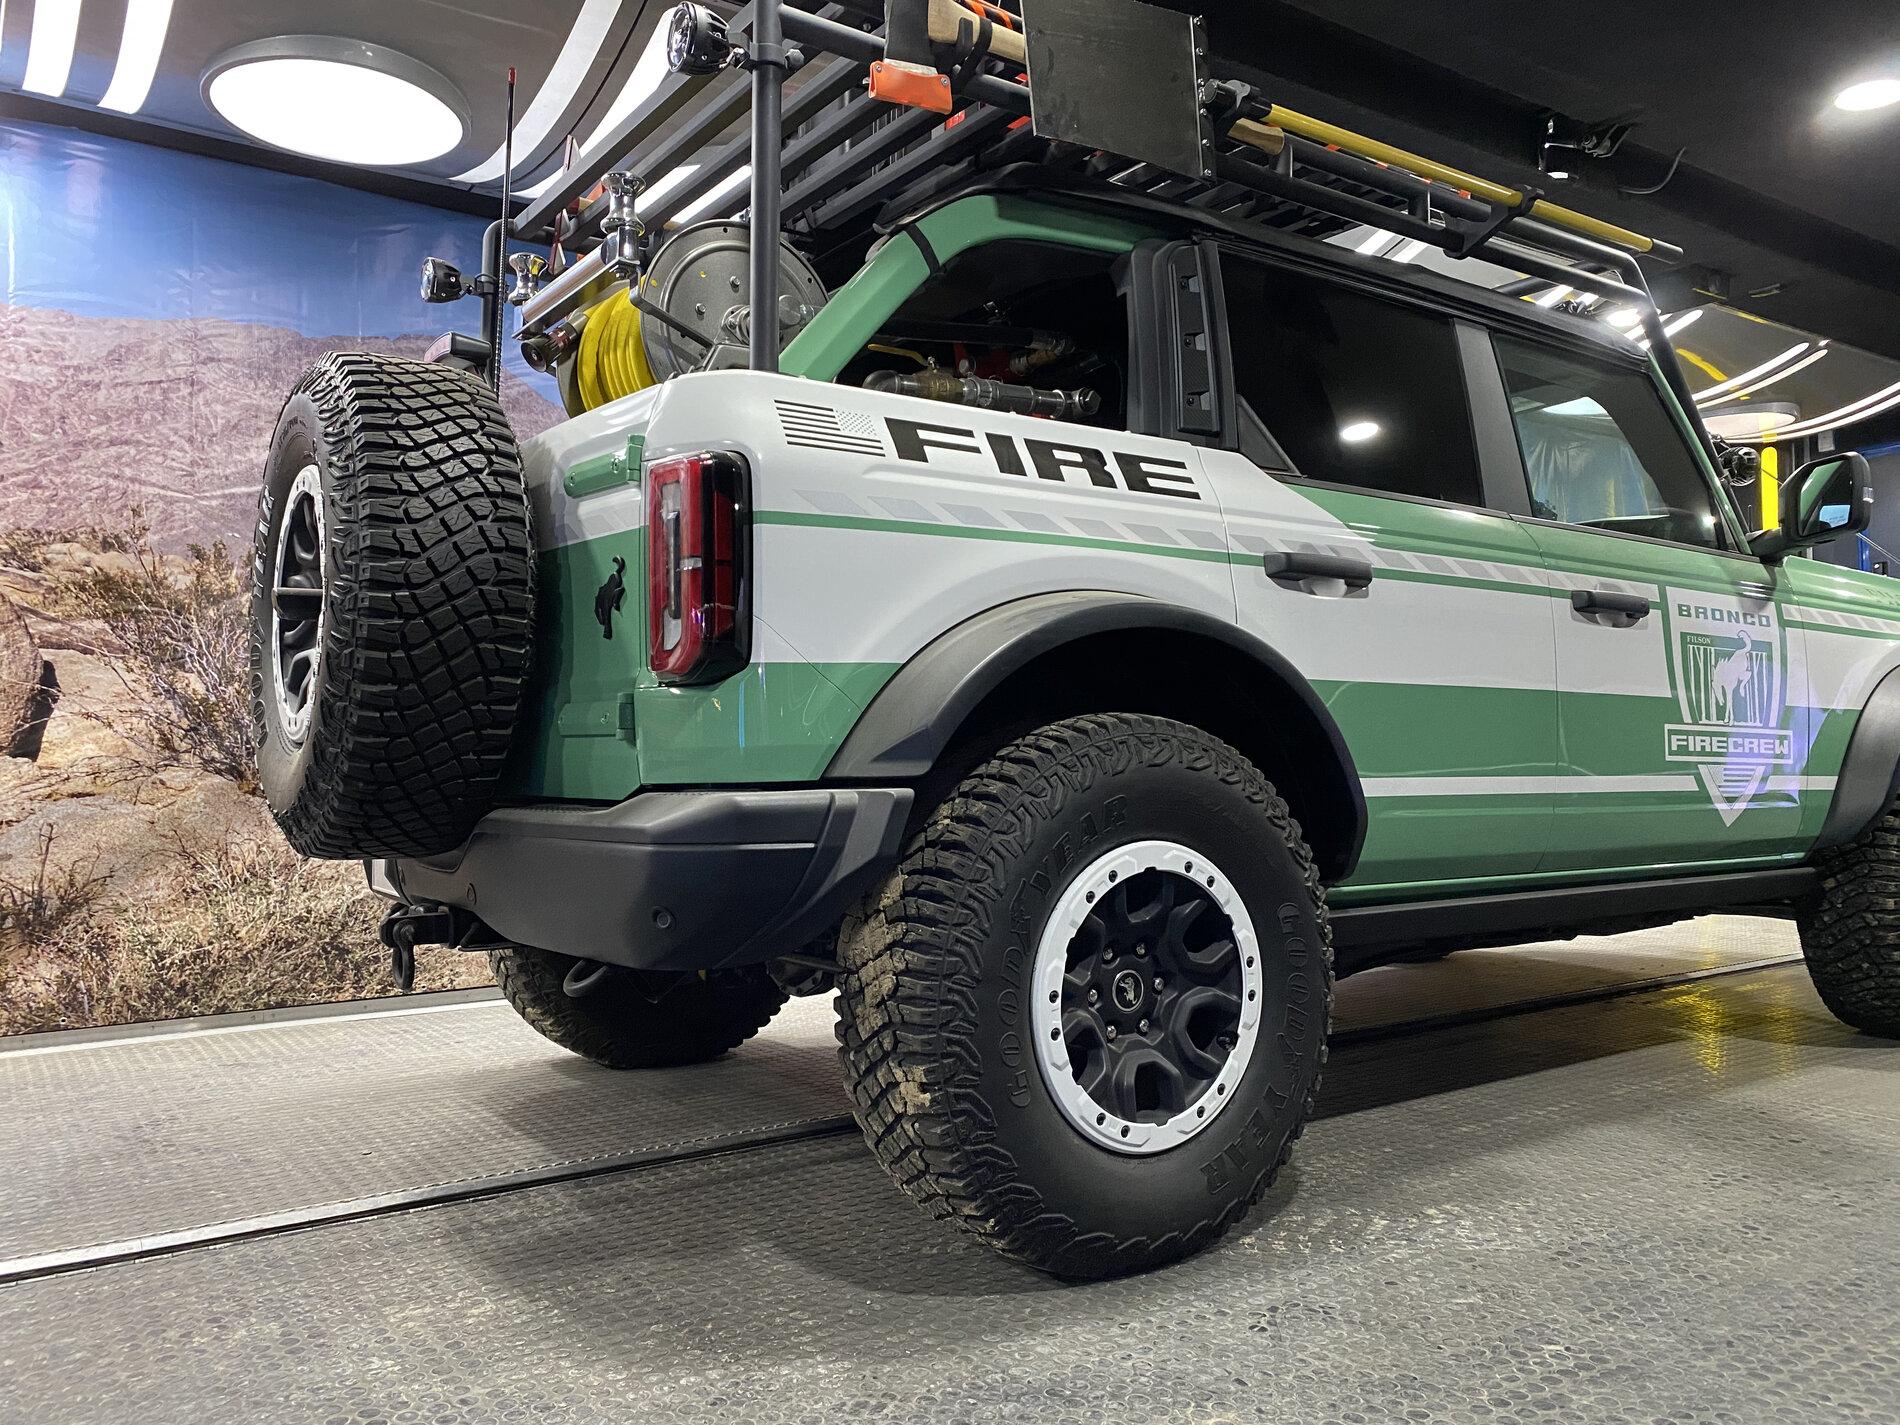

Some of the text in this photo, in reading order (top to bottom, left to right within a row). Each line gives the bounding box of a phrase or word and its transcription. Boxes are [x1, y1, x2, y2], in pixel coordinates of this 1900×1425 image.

[883, 416, 1202, 500] FIRE
[1677, 603, 1771, 628] BRONCO
[1686, 634, 1711, 645] FILSON
[1670, 734, 1789, 755] FIRECREW
[999, 794, 1128, 1108] GOODYEAR
[1199, 902, 1311, 1196] GOODYEAR
